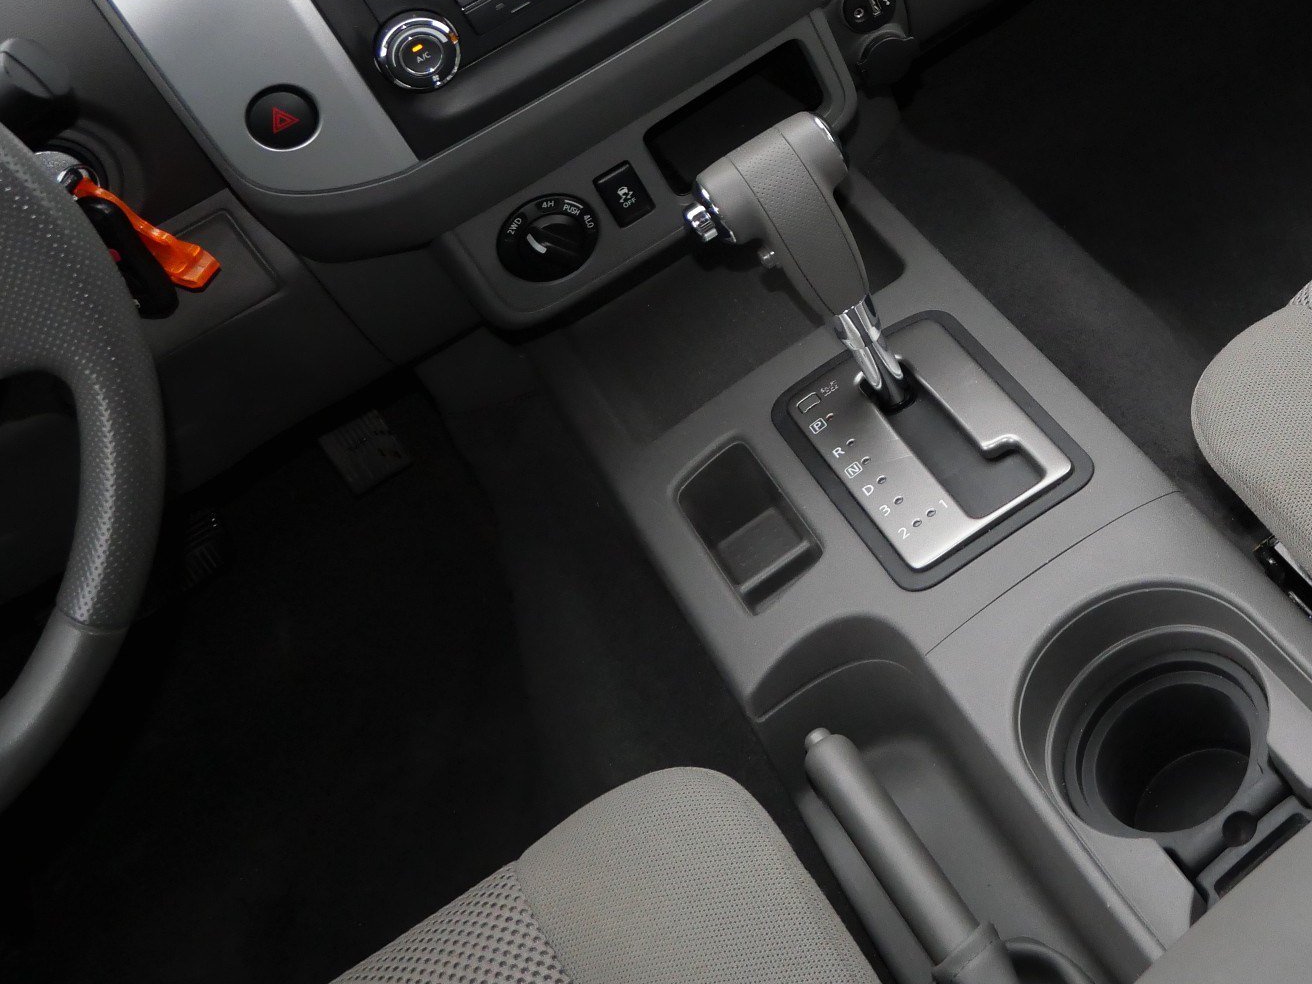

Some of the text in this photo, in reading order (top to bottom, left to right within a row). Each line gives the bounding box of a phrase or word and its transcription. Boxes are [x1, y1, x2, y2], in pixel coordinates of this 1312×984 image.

[416, 51, 431, 64] A/C
[541, 200, 555, 209] 4H
[622, 197, 637, 209] OFF
[562, 203, 580, 216] PUSH
[507, 217, 523, 235] 2WD
[832, 447, 845, 458] R
[862, 484, 875, 496] D
[879, 504, 891, 516] 3
[938, 499, 948, 509] 1
[898, 527, 910, 539] 2
